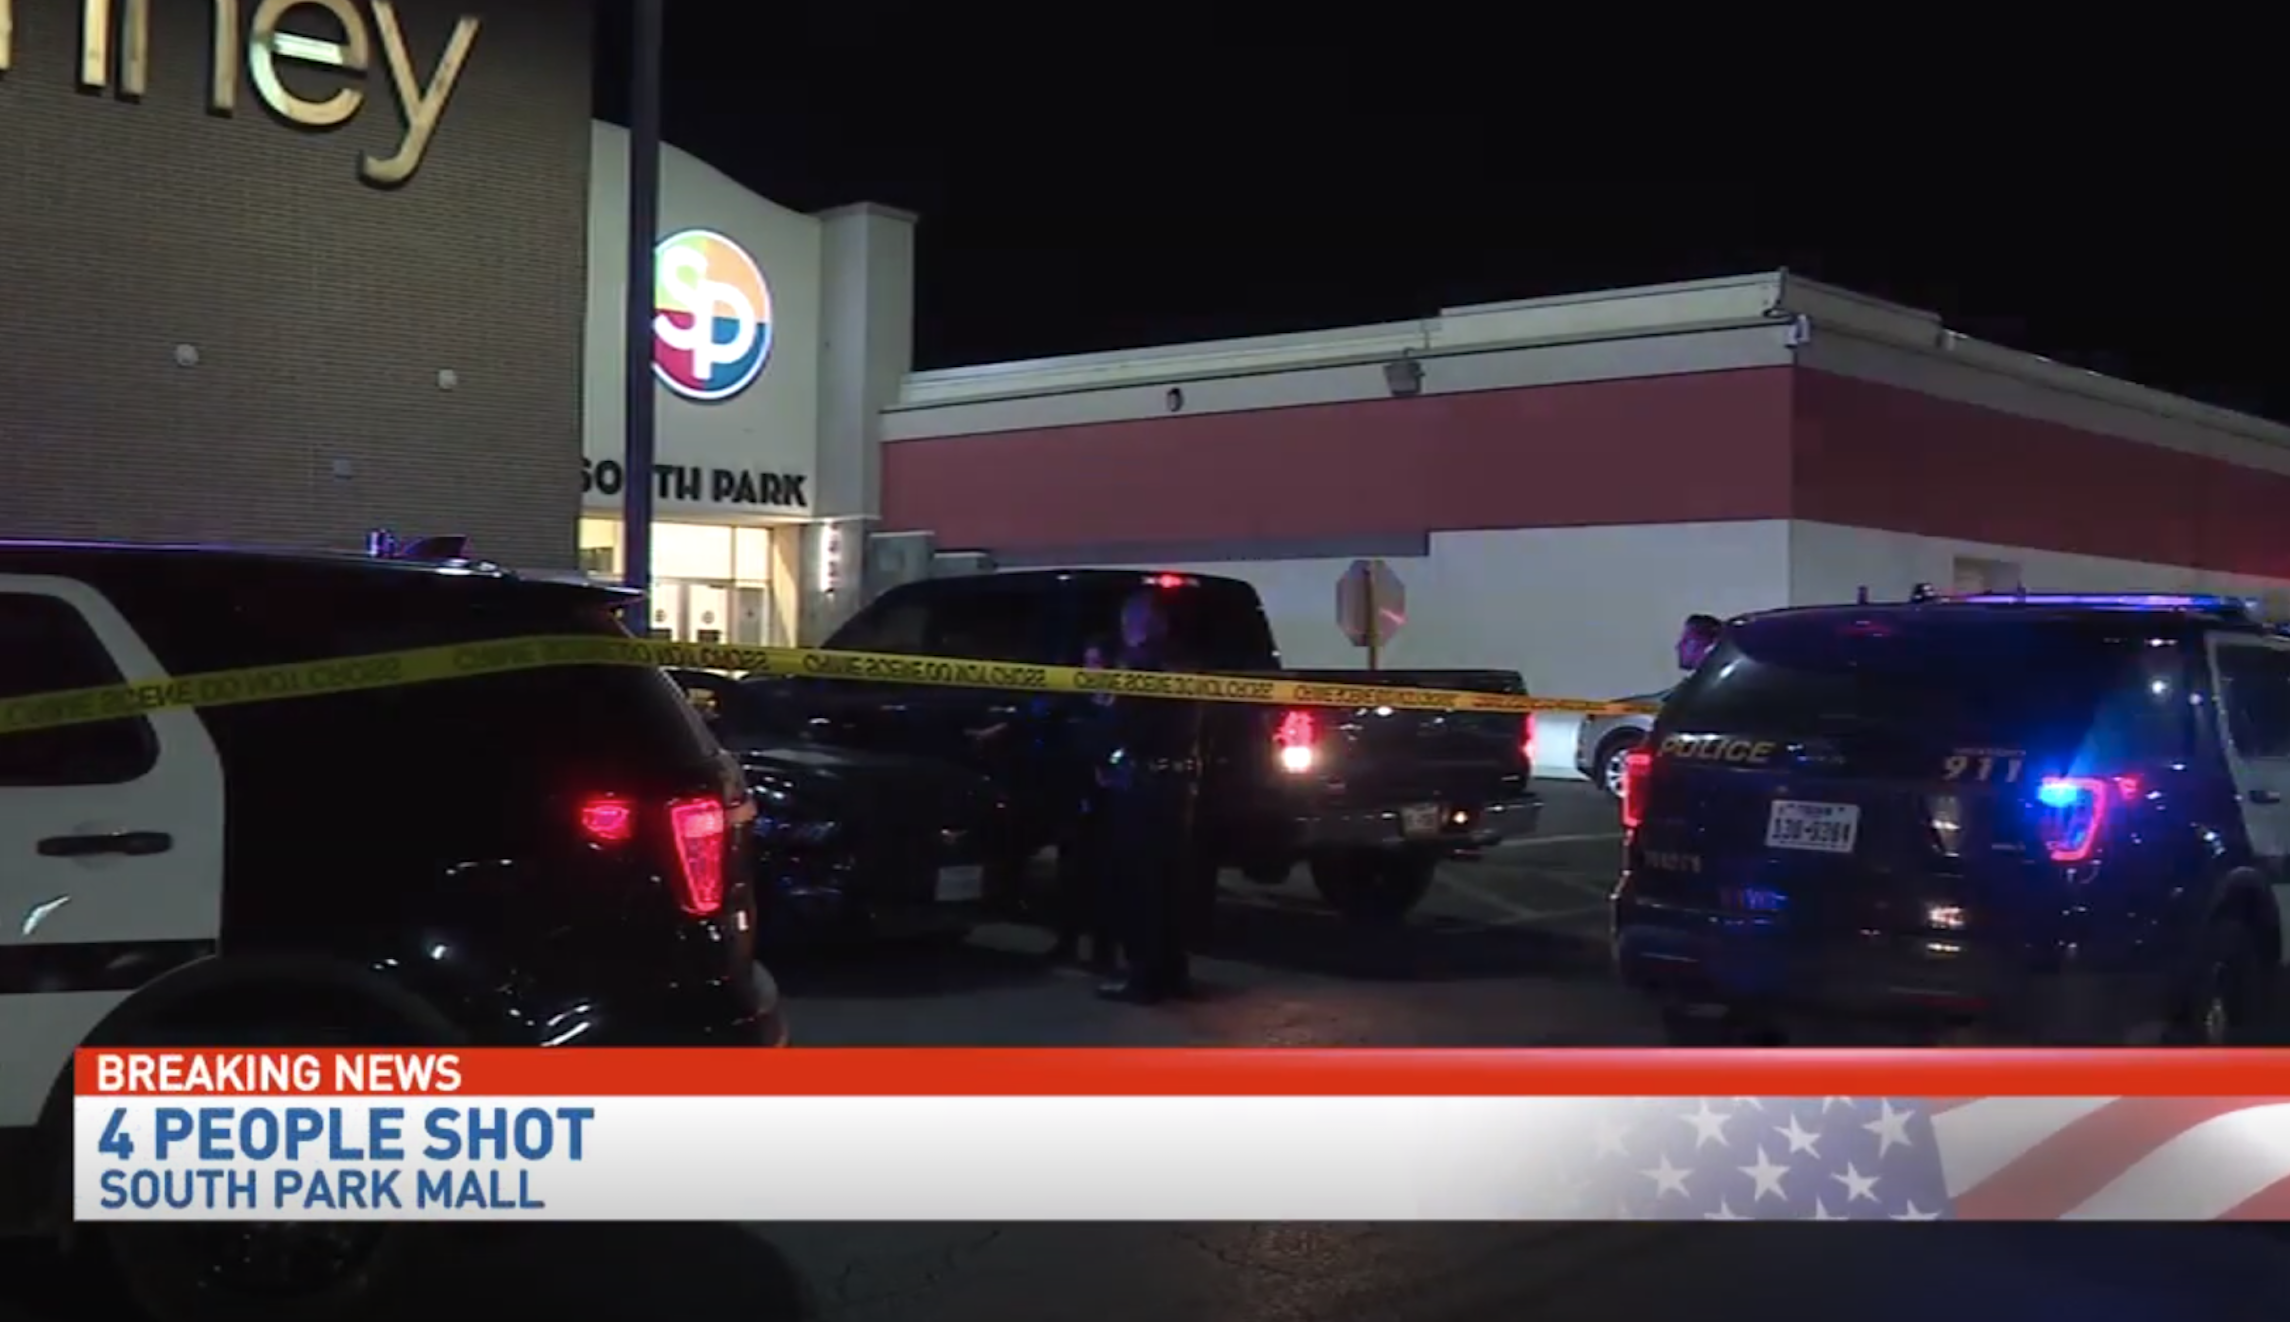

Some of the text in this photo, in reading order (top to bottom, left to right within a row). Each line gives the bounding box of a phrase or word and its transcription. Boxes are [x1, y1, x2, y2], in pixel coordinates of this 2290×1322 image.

[653, 245, 754, 380] SP
[711, 468, 808, 507] PARK
[1656, 736, 1777, 764] POLICE
[1942, 755, 2023, 783] 911
